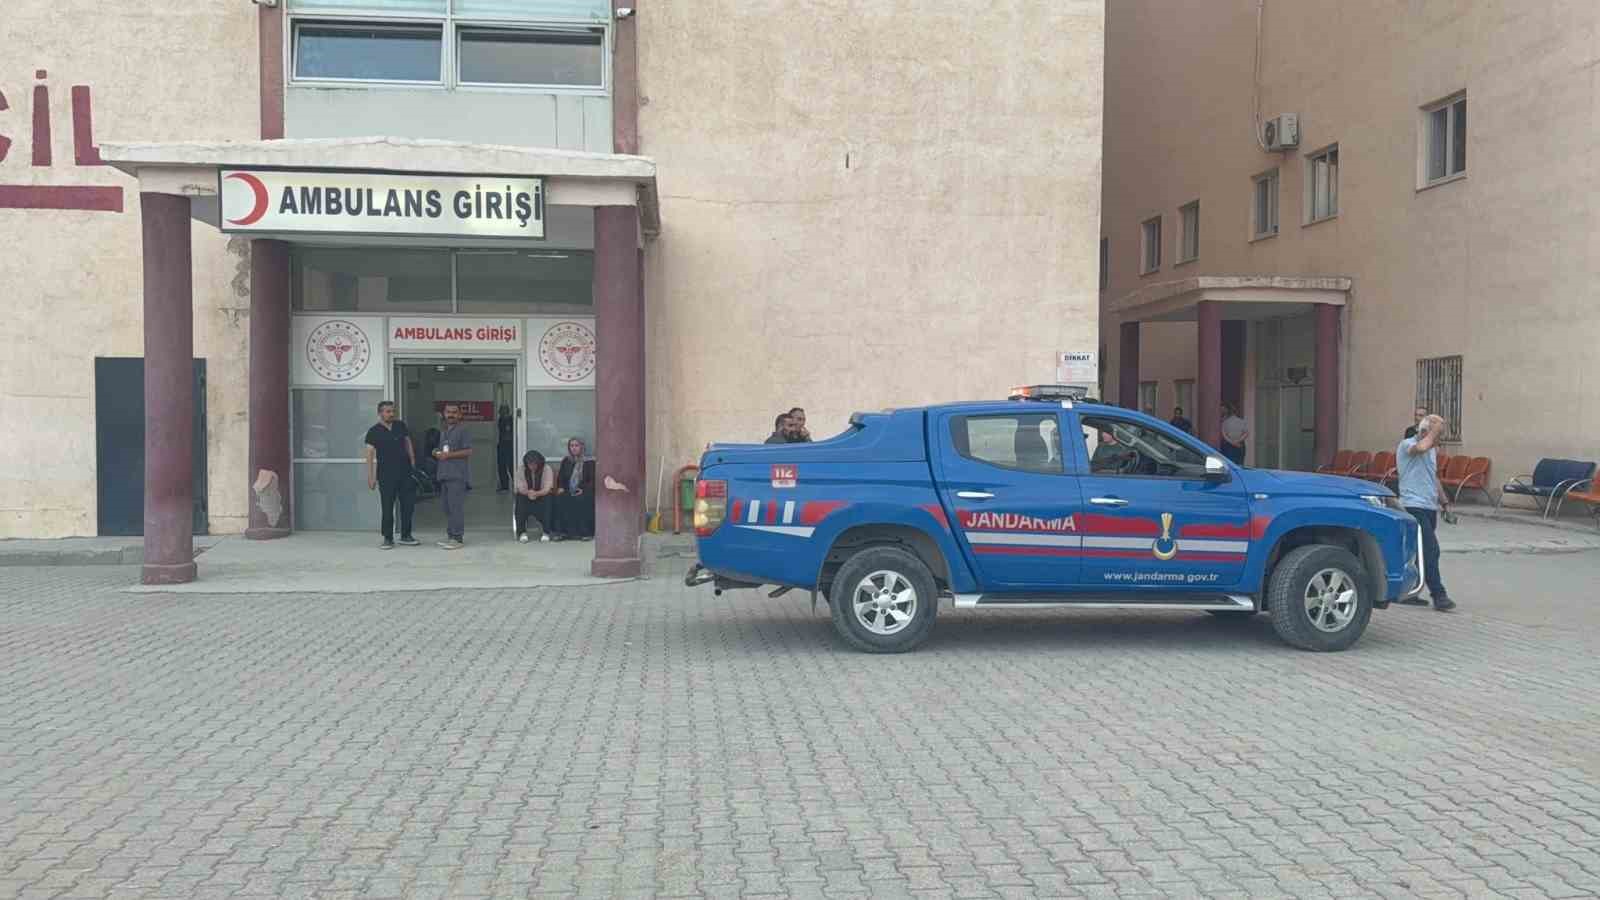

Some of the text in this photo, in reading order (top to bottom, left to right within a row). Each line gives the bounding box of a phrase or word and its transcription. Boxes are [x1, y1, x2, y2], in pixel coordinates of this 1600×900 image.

[279, 184, 542, 227] AMBULANS GİRİŞİ
[394, 325, 516, 342] AMBULANS GİRİŞİ
[775, 468, 793, 478] 112
[966, 512, 1076, 531] JANDARMA
[1103, 571, 1218, 583] www.jandarmagov.tr
